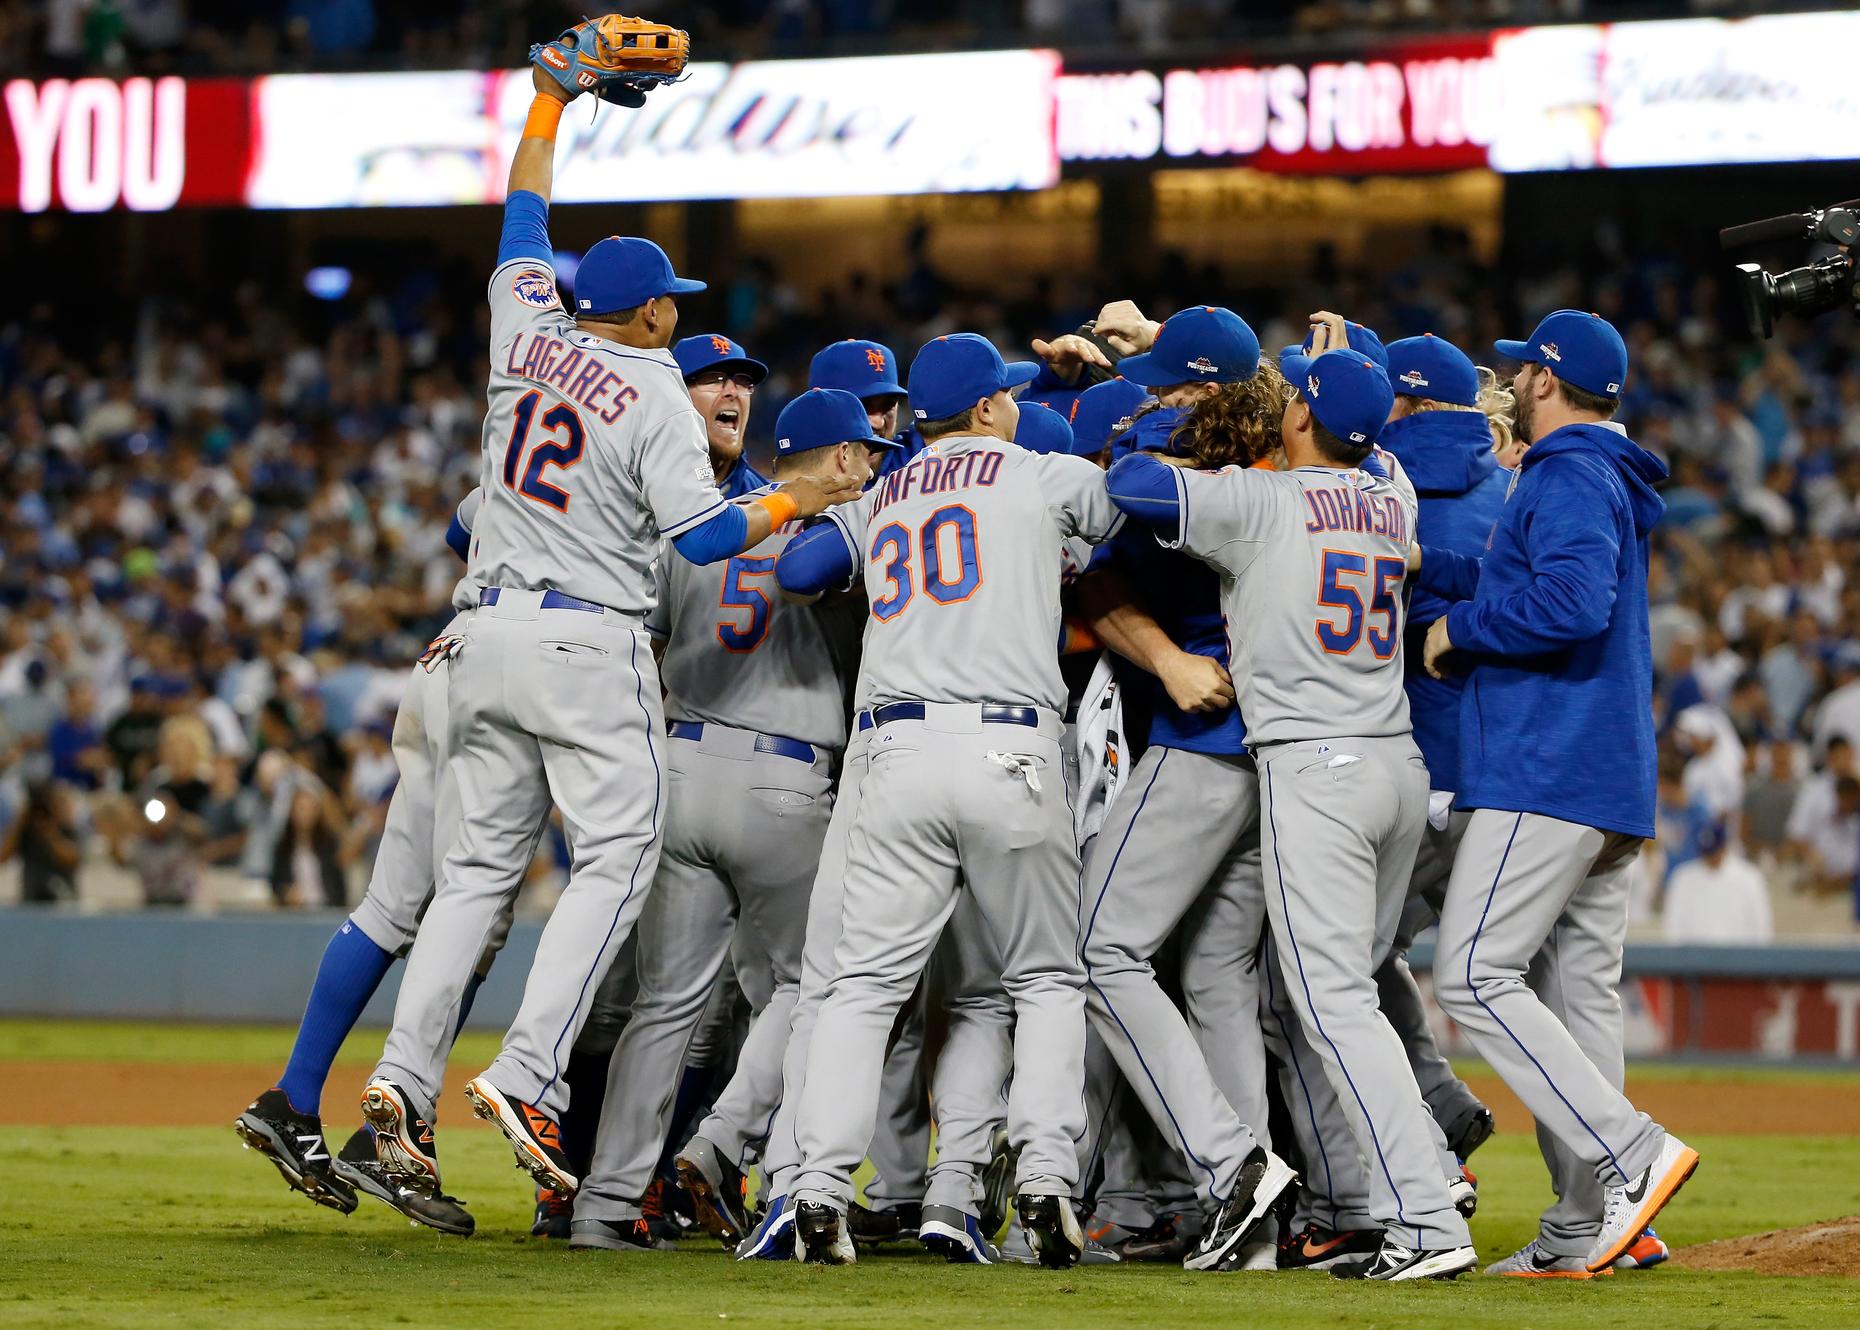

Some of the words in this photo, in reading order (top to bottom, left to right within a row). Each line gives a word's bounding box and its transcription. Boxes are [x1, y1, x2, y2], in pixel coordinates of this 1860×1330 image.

[6, 77, 187, 212] YOU
[1309, 61, 1405, 151] FOR
[506, 332, 640, 426] LAGARES
[503, 388, 587, 514] 12
[717, 553, 779, 654] 5
[871, 503, 984, 624] 30
[1315, 548, 1408, 660] 55
